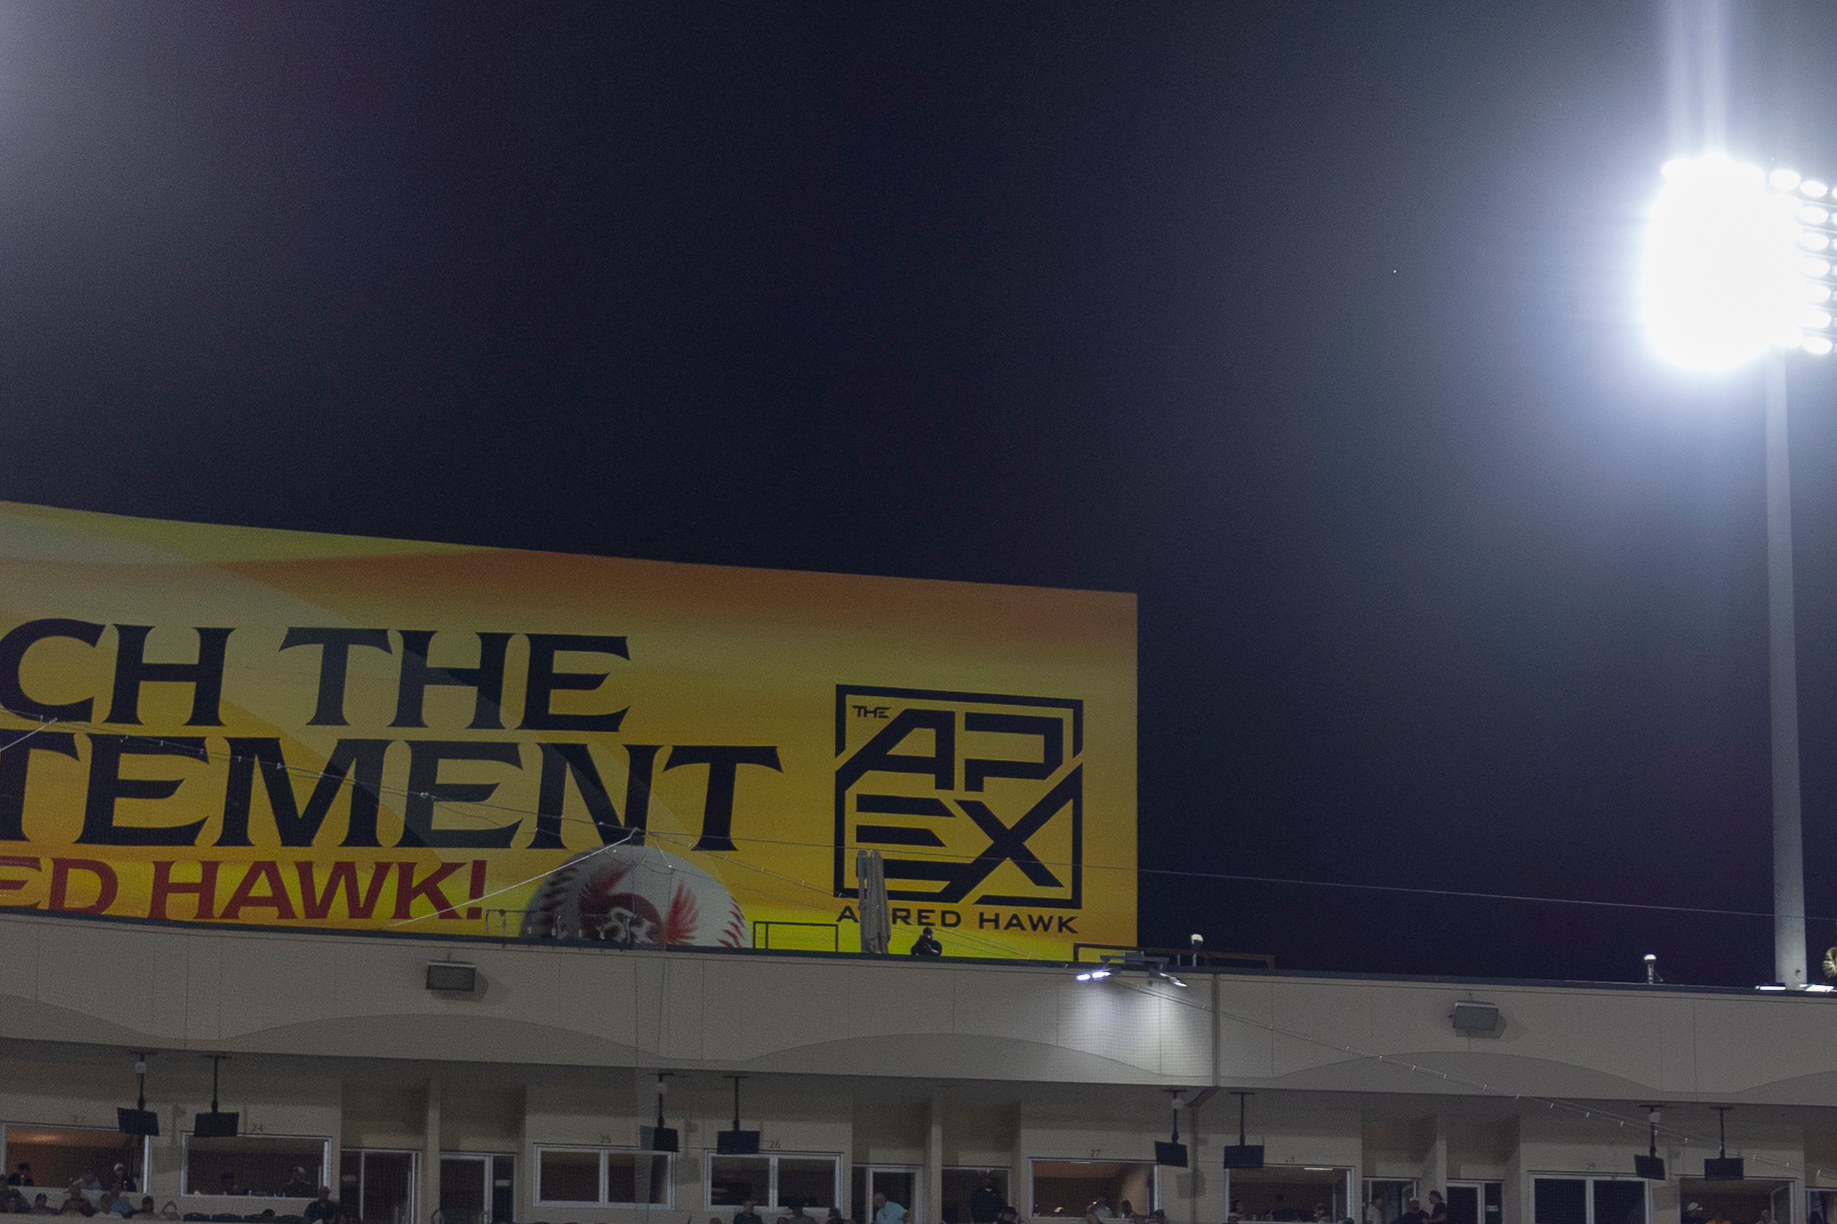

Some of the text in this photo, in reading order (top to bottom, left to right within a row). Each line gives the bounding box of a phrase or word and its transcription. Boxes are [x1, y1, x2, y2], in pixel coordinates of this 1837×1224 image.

[0, 618, 631, 732] CH THE
[851, 704, 892, 719] THE
[0, 728, 784, 851] TEMENT
[147, 860, 487, 920] HAWK!
[892, 908, 962, 928] RED
[979, 911, 1079, 934] HAWK
